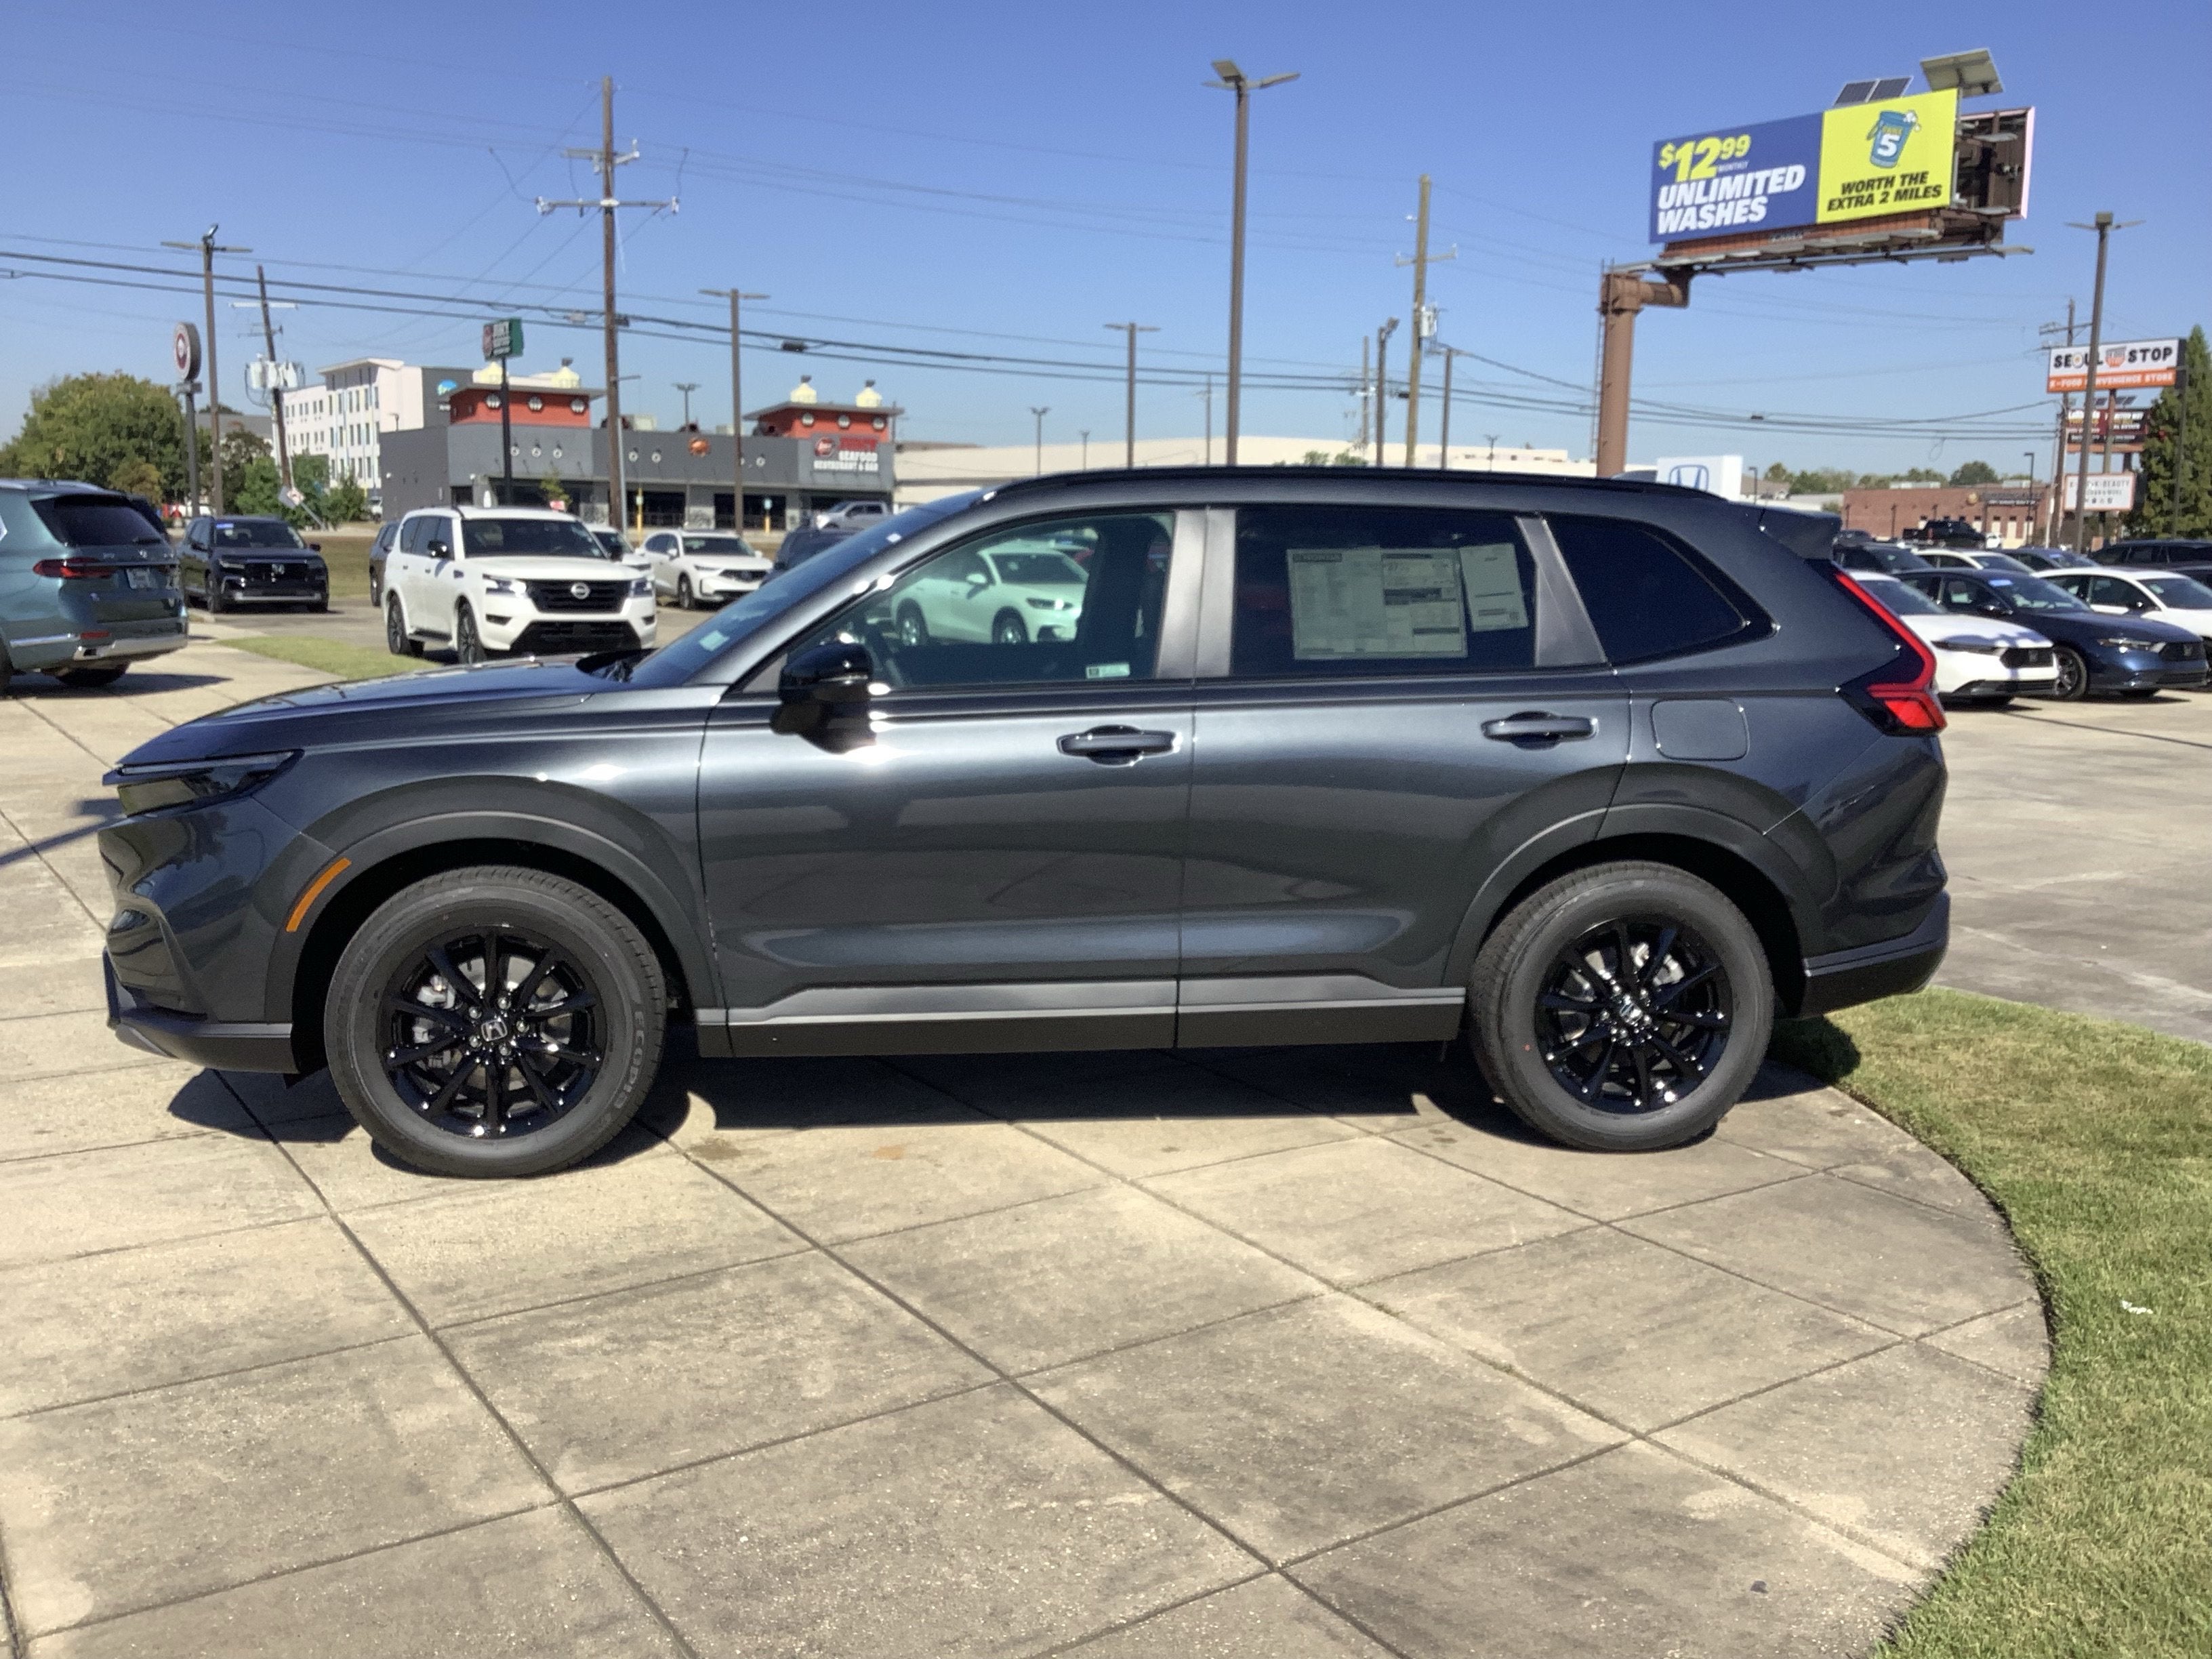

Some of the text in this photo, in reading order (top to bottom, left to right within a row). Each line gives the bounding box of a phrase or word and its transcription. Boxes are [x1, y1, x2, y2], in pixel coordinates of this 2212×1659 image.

[1877, 133, 1900, 157] 5
[1658, 164, 1806, 209] UNLIMITED
[1841, 171, 1929, 196] WORTH THE
[1827, 184, 1942, 212] EXTRA 2 MILES
[1657, 196, 1768, 235] WASHES
[2127, 346, 2173, 364] STOP
